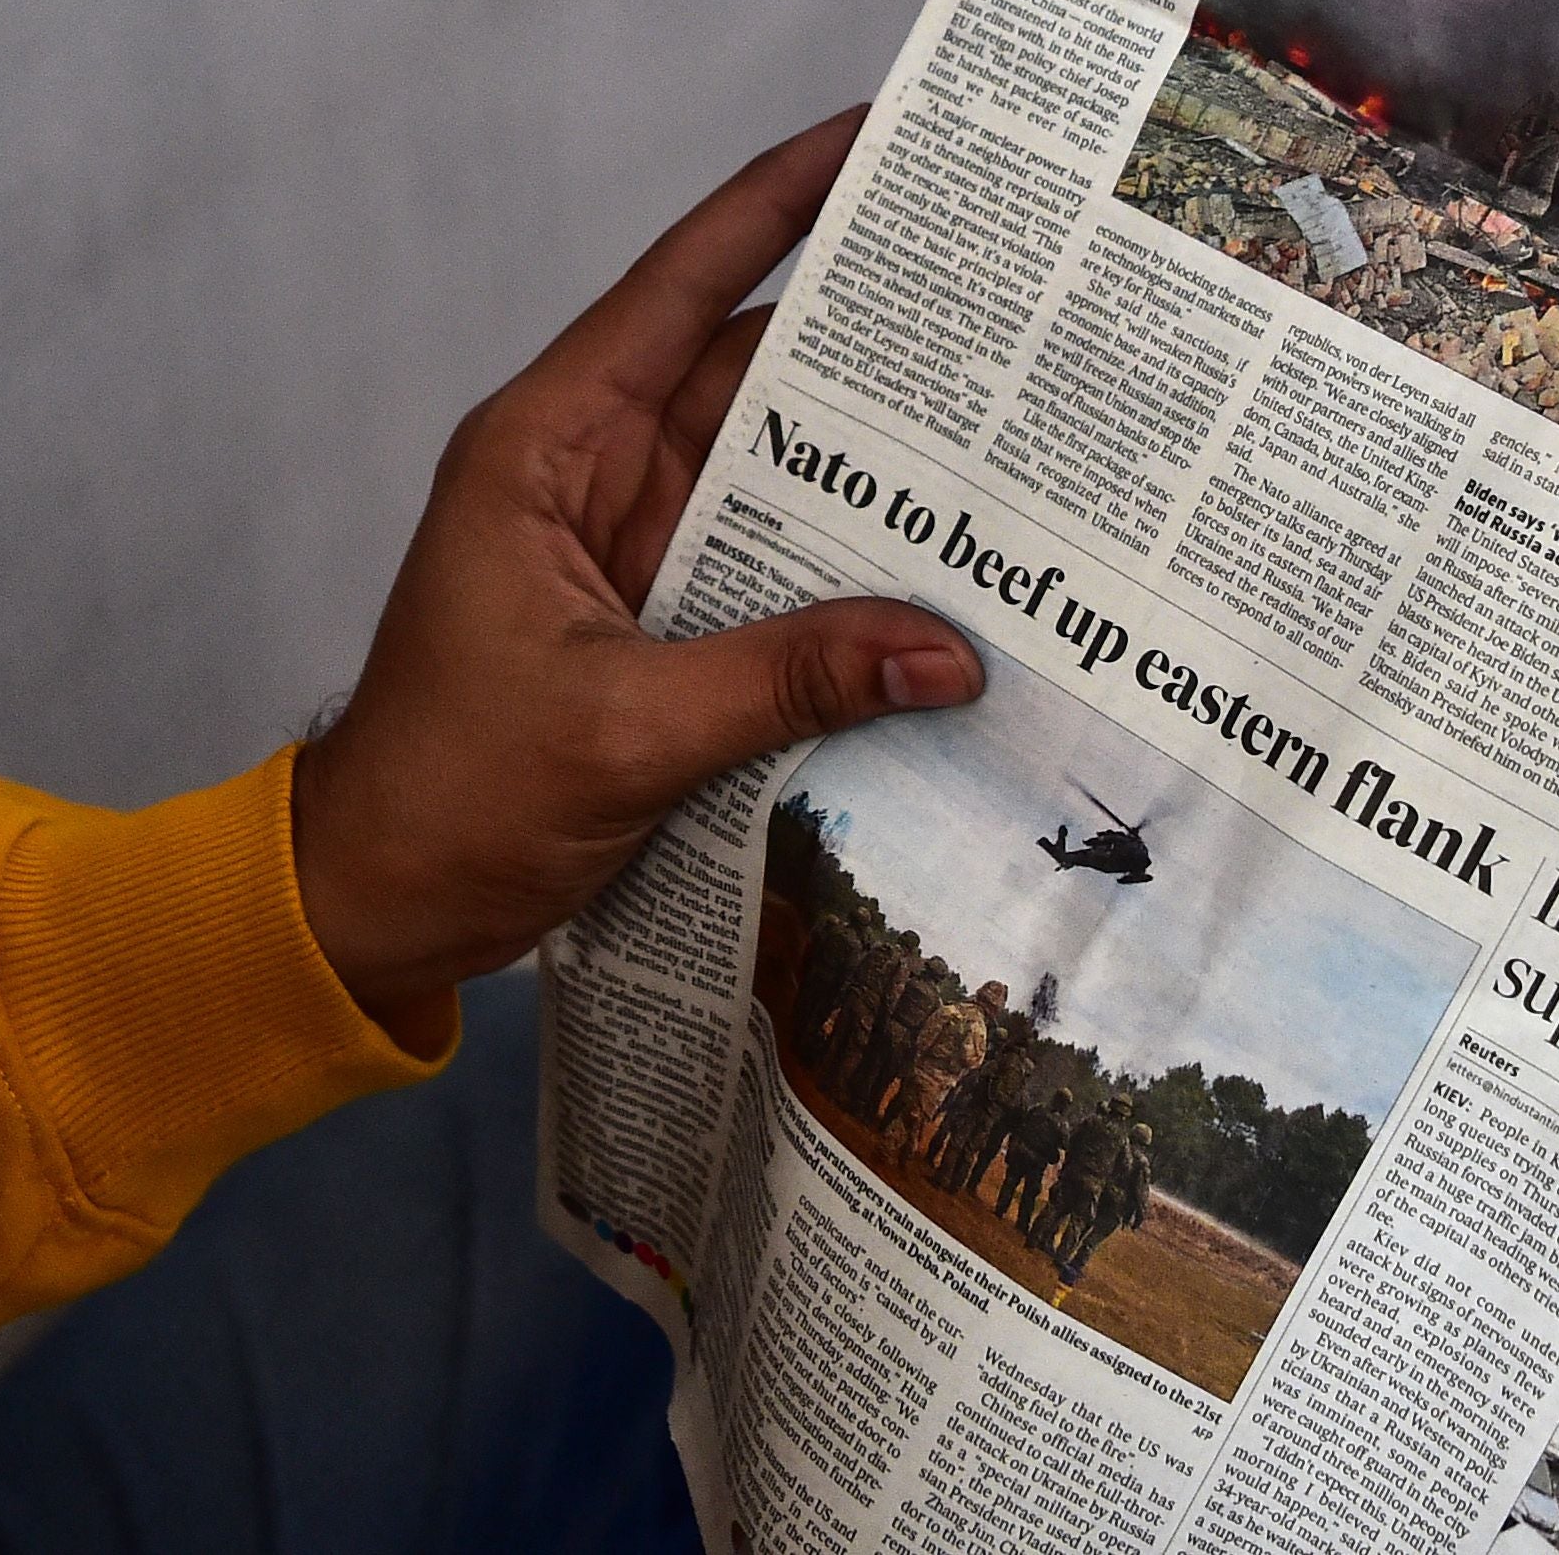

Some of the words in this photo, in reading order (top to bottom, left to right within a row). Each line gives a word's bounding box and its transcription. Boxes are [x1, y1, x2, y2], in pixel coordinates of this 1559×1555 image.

[1095, 224, 1152, 262] economy
[1149, 249, 1168, 270] by
[1165, 257, 1219, 298] blocking
[1216, 286, 1238, 305] the
[1235, 297, 1274, 323] access
[1208, 475, 1277, 520] emergency
[1274, 509, 1307, 535] talks
[1305, 528, 1339, 555] early
[1333, 542, 1393, 586] Thursday
[1232, 462, 1258, 487] The
[1257, 477, 1291, 505] Nato
[1291, 499, 1344, 535] alliance
[1343, 528, 1389, 559] agreed
[1386, 552, 1403, 568] at
[1453, 494, 1492, 525] hold
[1488, 514, 1543, 555] Russia
[1463, 478, 1508, 513] Biden
[1507, 506, 1546, 533] says
[746, 406, 878, 510] Nato
[884, 487, 936, 545] to
[938, 511, 1066, 621] beef
[1055, 595, 1129, 675] up
[1135, 649, 1330, 797] eastern
[1329, 759, 1510, 897] flank
[1458, 1033, 1521, 1078] Reuters
[1422, 1096, 1458, 1130] long
[1458, 1121, 1512, 1158] queues
[1512, 1151, 1556, 1192] trying
[1432, 1080, 1474, 1113] KIEV:
[1478, 1106, 1530, 1147] People
[1530, 1139, 1548, 1161] in
[813, 1139, 885, 1208] paratroopers
[883, 1201, 915, 1234] train
[913, 1227, 975, 1279] alongside
[973, 1271, 1009, 1302] their
[1006, 1292, 1051, 1332] Polish
[1050, 1325, 1091, 1353] allies
[1089, 1346, 1154, 1388] assigned
[1152, 1379, 1168, 1396] to
[1168, 1388, 1194, 1410] the
[1192, 1400, 1223, 1426] 21st
[817, 1164, 862, 1215] training,
[860, 1207, 876, 1225] at
[872, 1214, 908, 1252] Nowa
[905, 1241, 940, 1281] Deba,
[940, 1268, 990, 1315] Poland.
[1191, 1424, 1214, 1441] AFP
